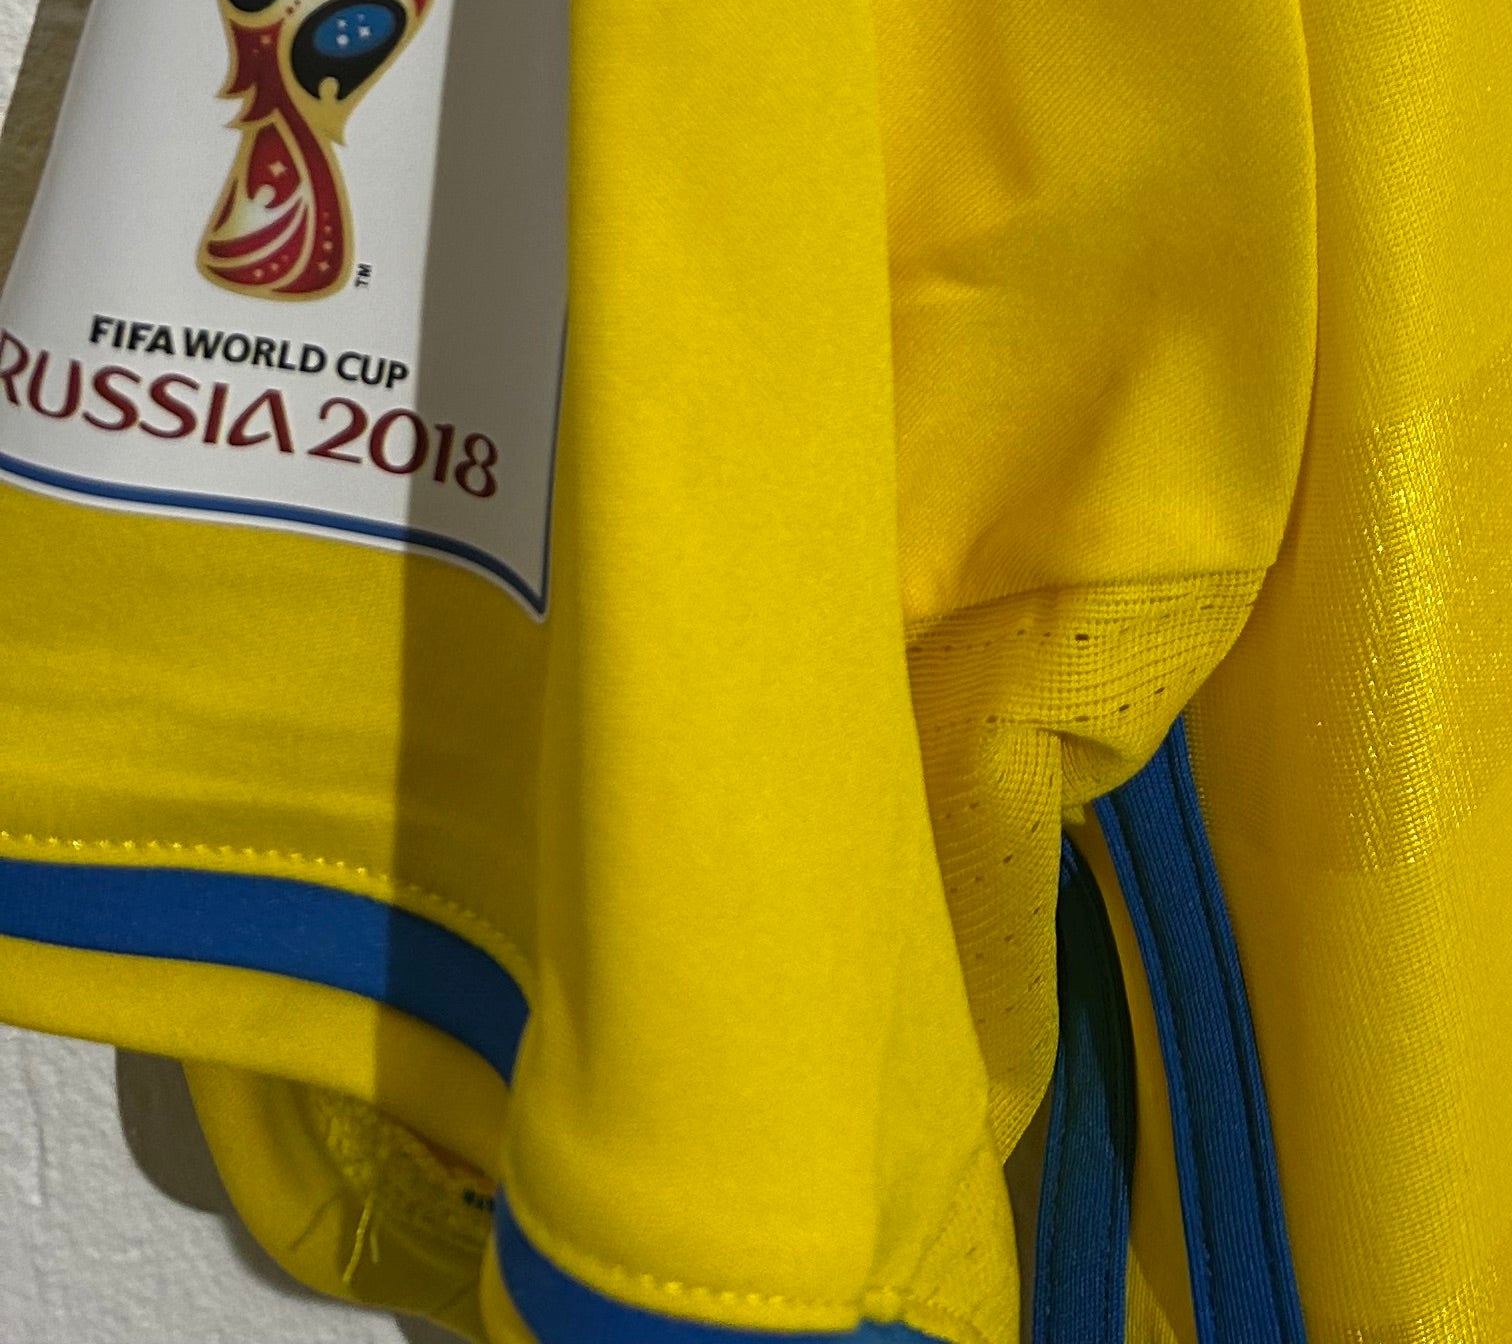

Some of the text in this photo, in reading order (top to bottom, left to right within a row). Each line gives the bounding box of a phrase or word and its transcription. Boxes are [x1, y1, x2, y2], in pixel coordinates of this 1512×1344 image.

[354, 263, 372, 288] TM
[89, 313, 410, 390] FIFA WORLD CUP
[0, 327, 500, 499] RUSSIA 2018
